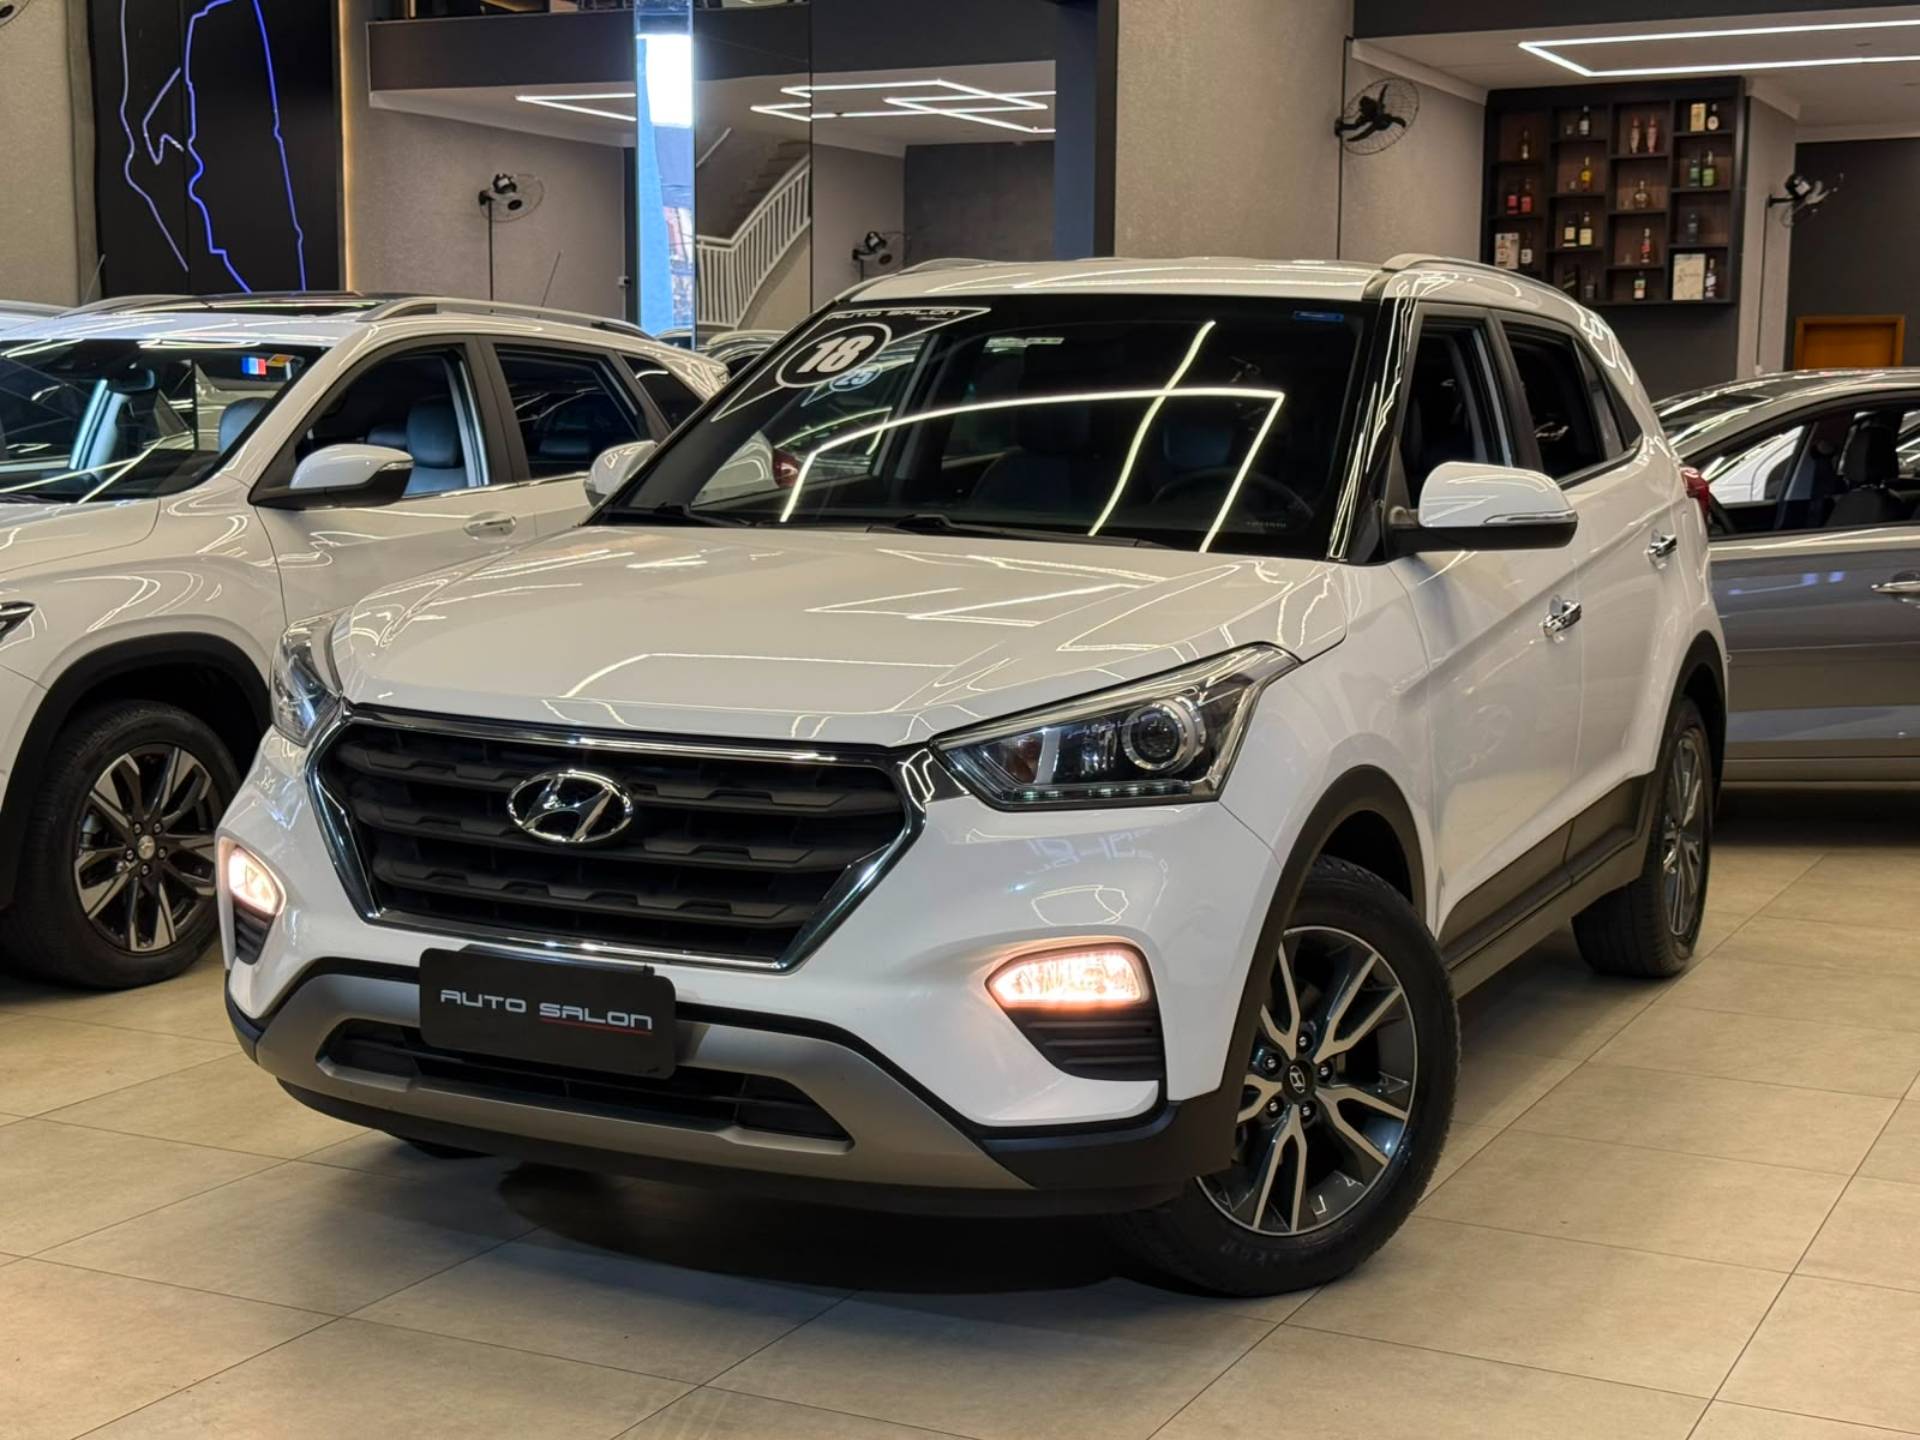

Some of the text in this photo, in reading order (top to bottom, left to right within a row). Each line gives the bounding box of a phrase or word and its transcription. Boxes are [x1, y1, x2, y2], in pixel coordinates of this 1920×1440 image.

[796, 335, 876, 374] 18
[440, 989, 653, 1030] AUTO SALON
